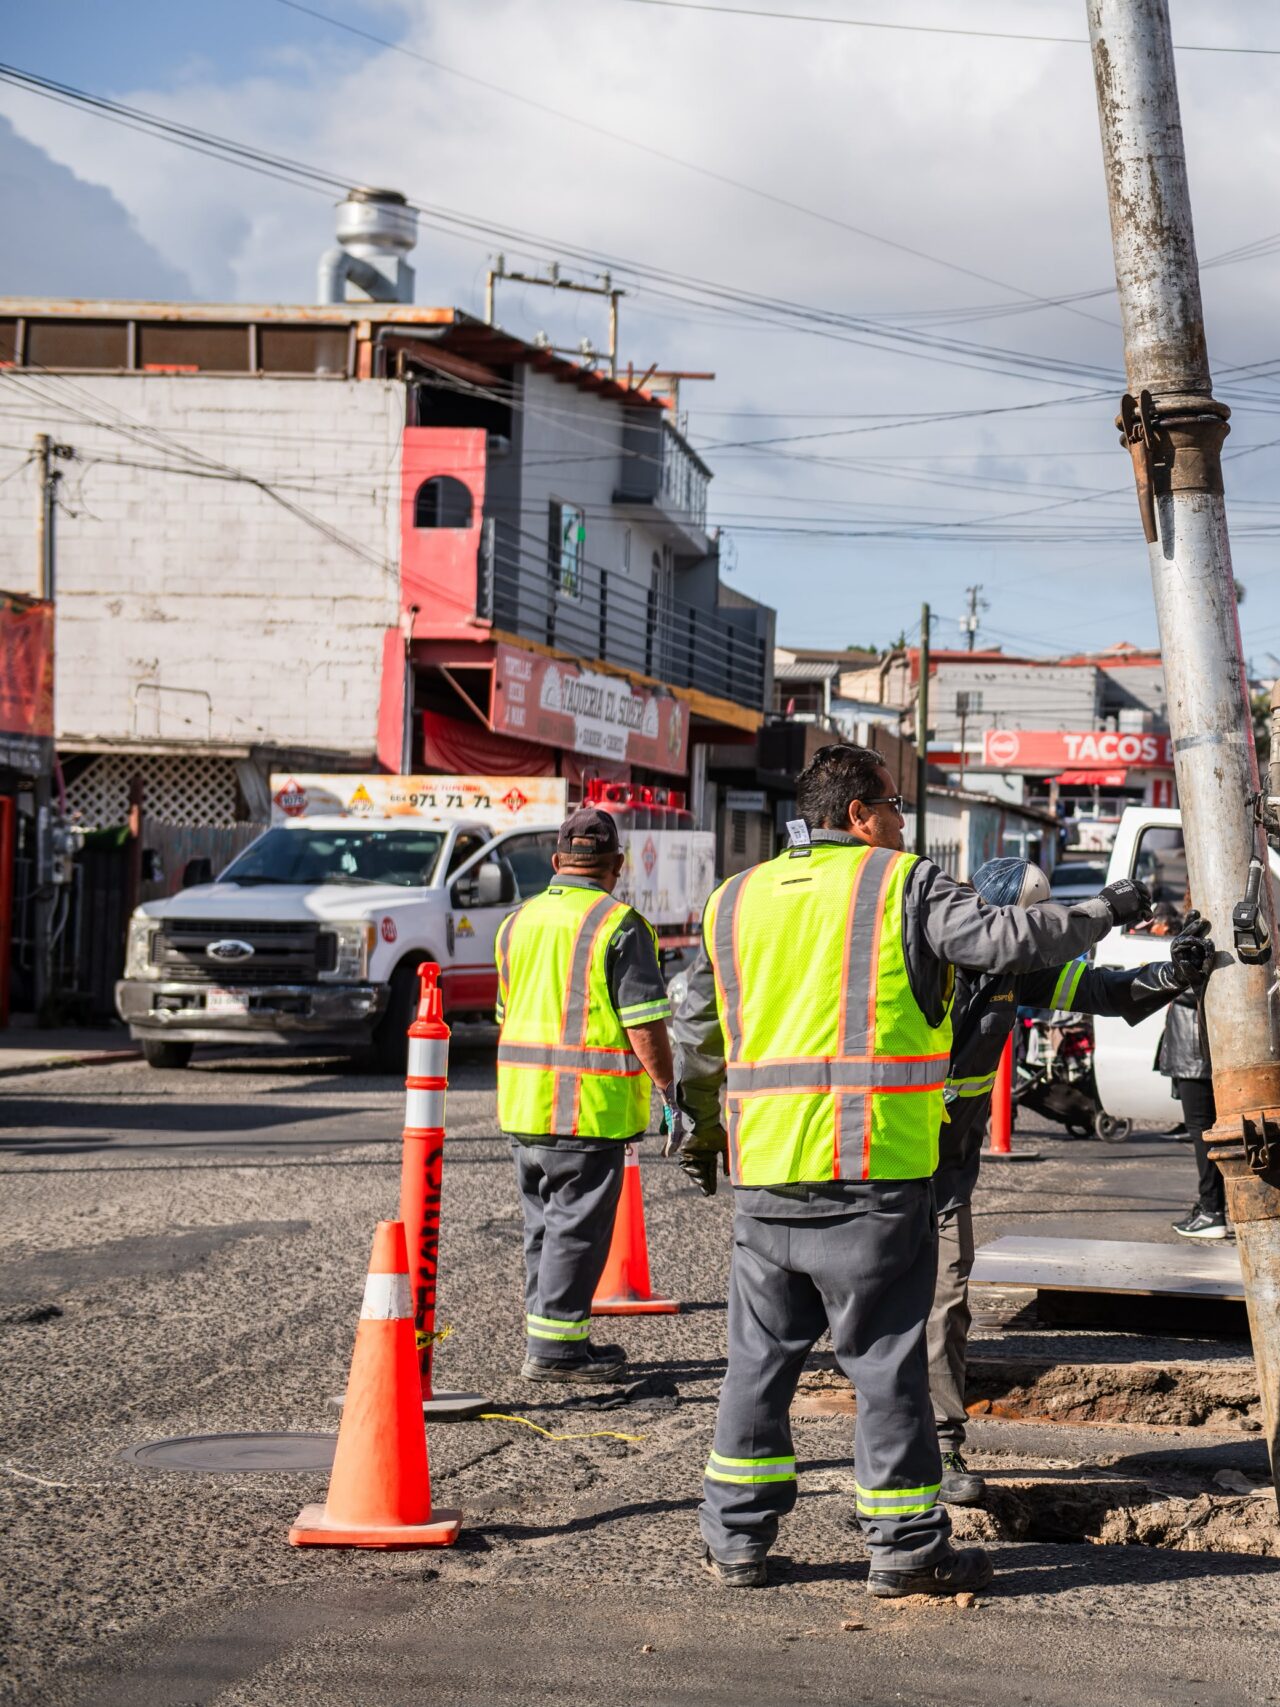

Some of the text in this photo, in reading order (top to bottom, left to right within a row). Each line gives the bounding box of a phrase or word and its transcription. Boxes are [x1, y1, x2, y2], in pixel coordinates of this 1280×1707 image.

[1063, 735, 1158, 762] TACOS
[409, 793, 437, 808] 971
[446, 794, 464, 808] 71
[473, 795, 492, 809] 71
